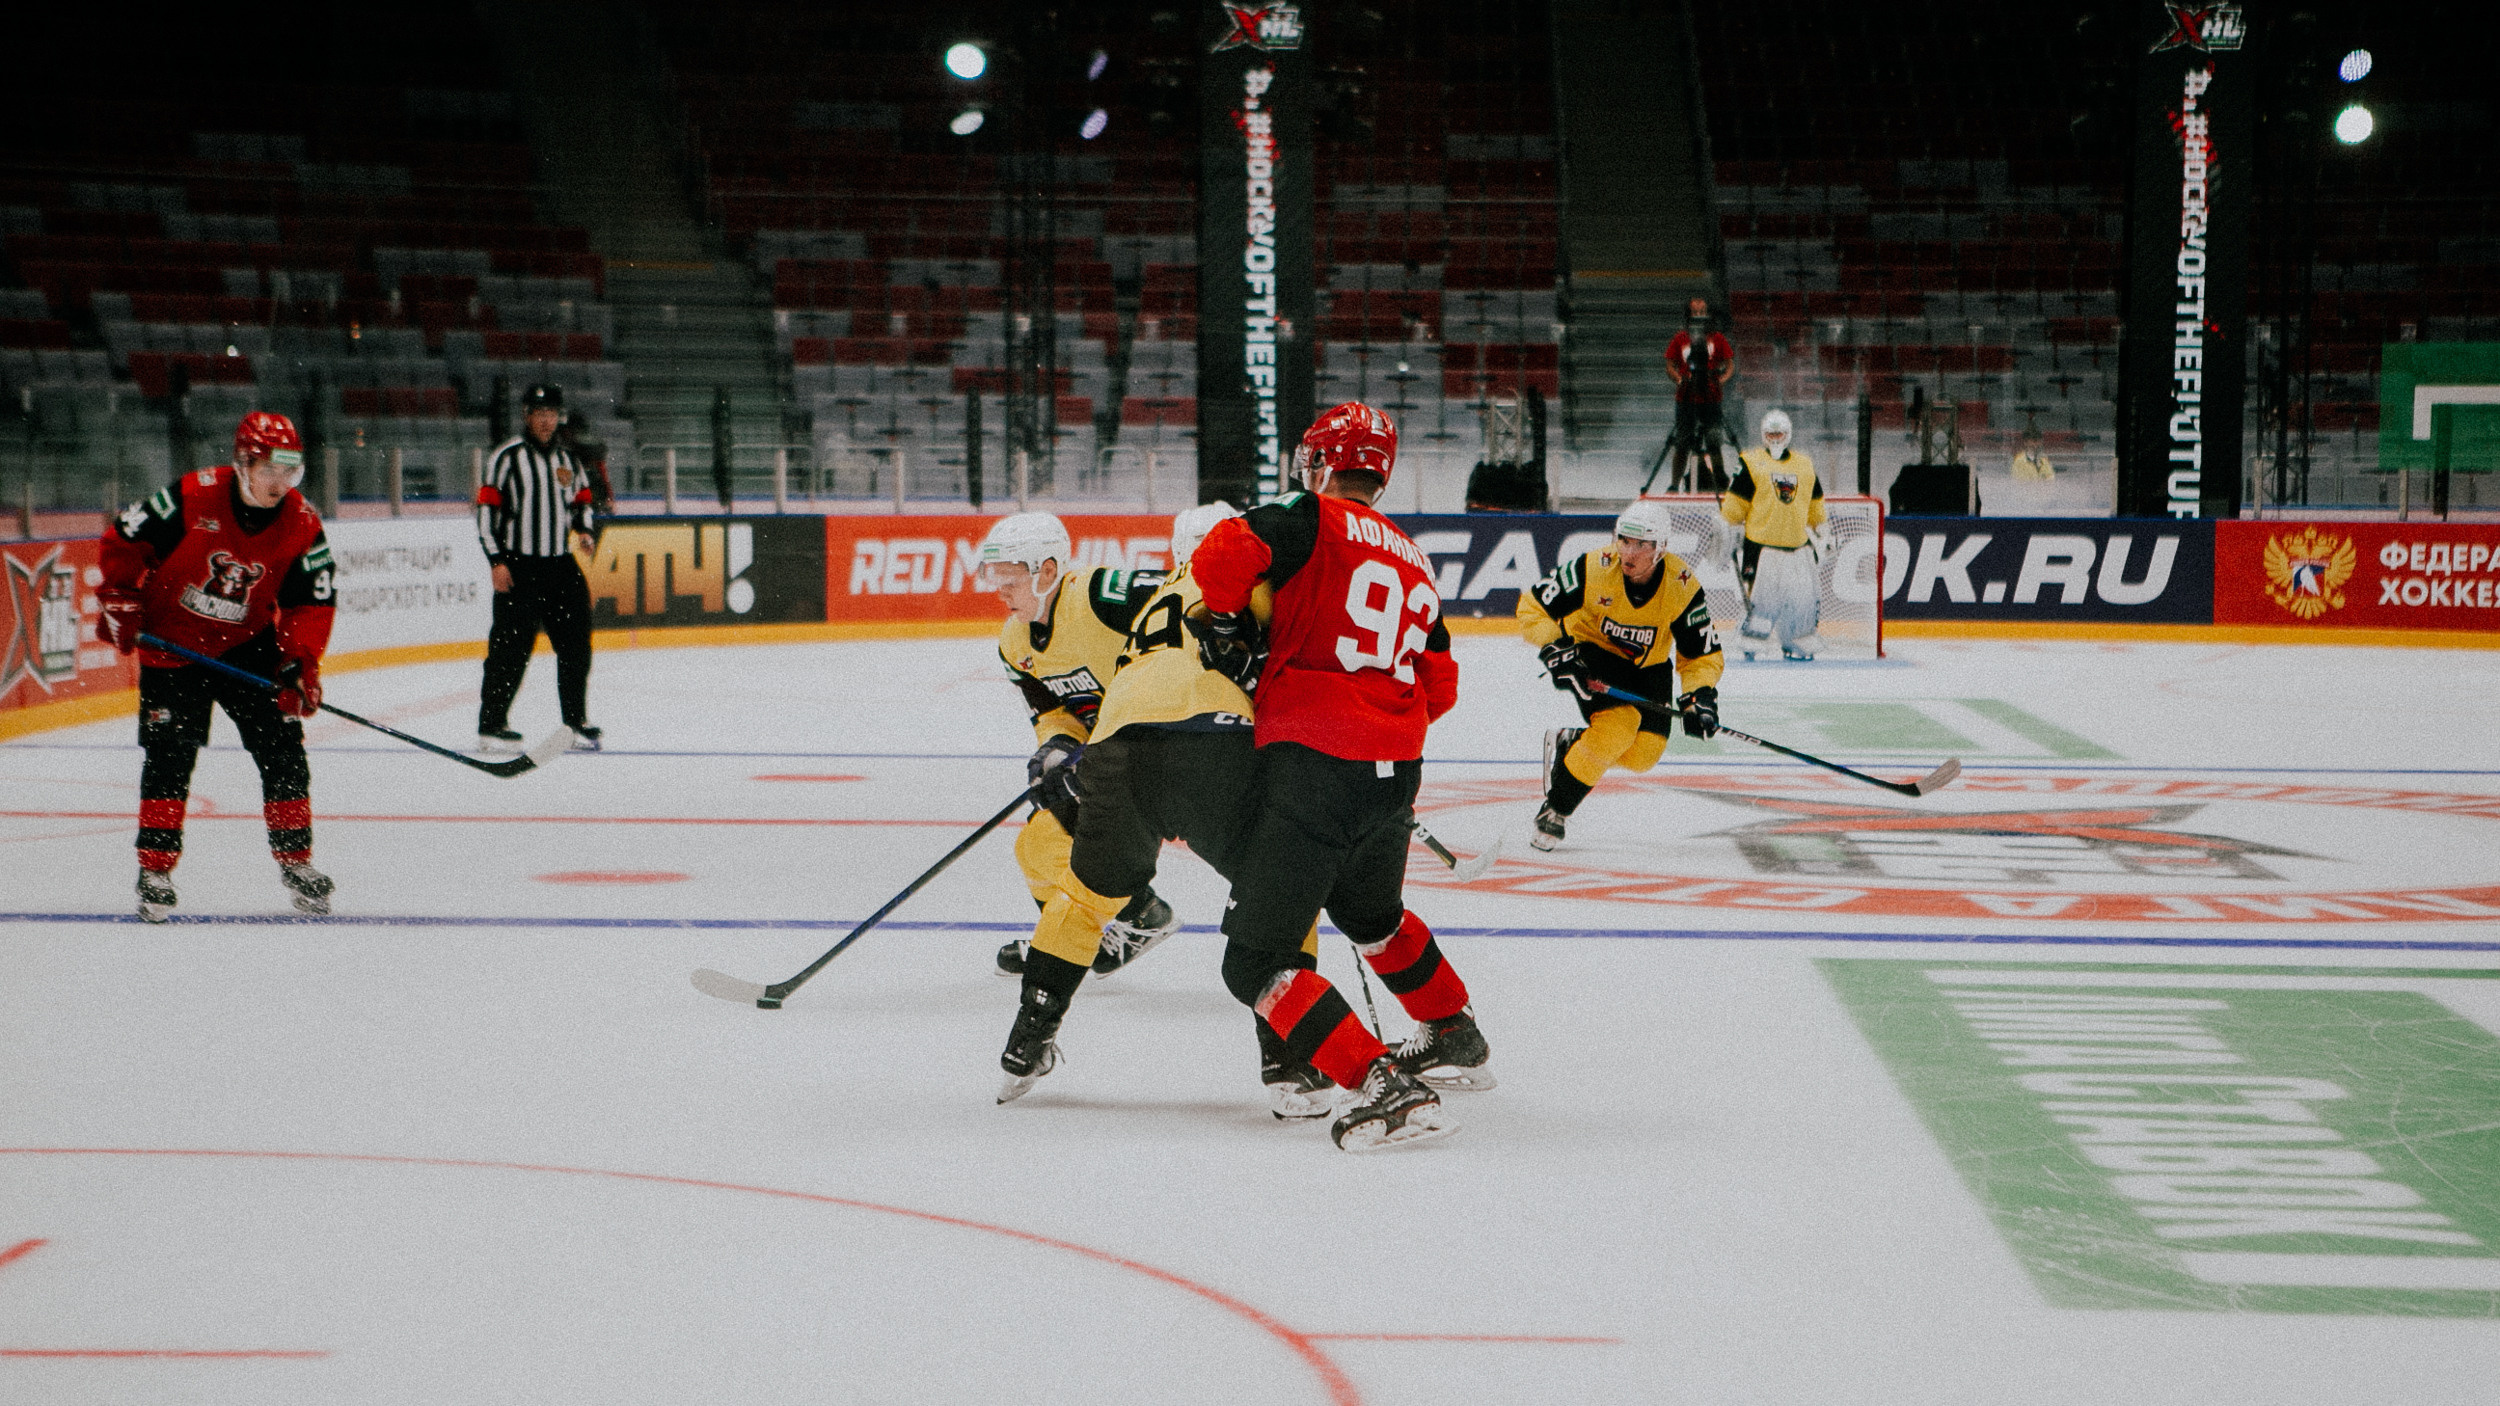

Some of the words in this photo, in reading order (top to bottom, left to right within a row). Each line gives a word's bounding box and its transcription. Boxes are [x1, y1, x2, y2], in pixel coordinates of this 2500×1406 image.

[850, 538, 948, 595] RED
[1335, 559, 1440, 685] 92
[1603, 619, 1655, 645] РОСТОВ
[2010, 1072, 2486, 1247] СТАВОК
